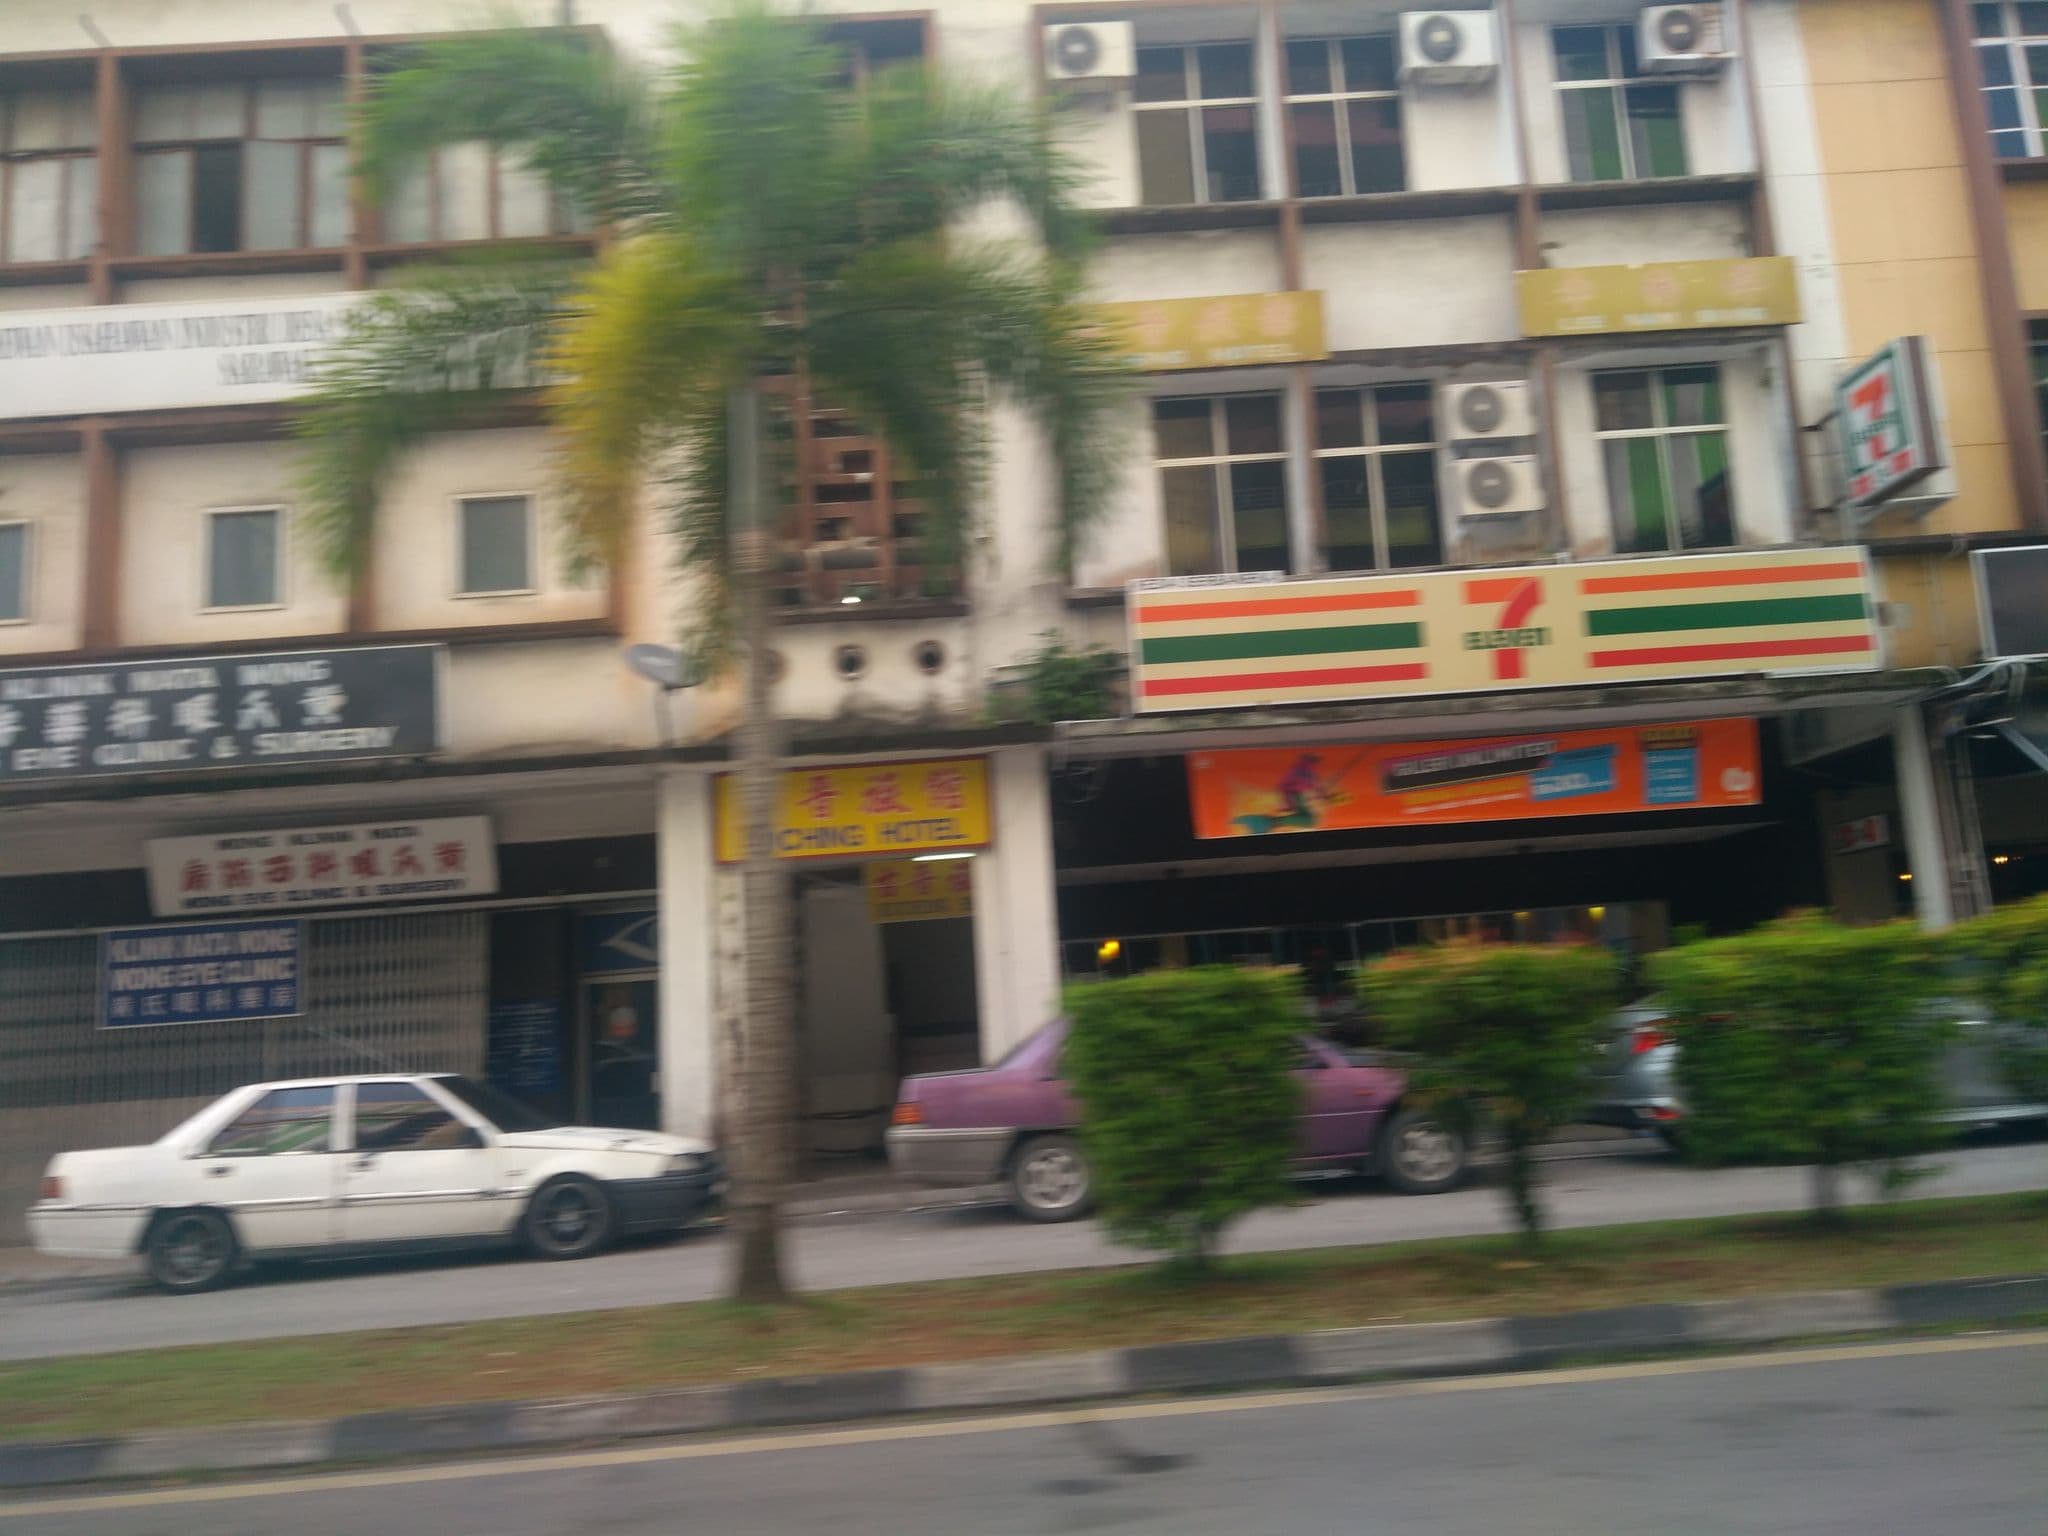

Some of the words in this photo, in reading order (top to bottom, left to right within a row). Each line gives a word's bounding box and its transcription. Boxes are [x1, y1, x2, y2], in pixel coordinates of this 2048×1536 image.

[1463, 576, 1545, 680] 7
[11, 746, 80, 771] EYE
[93, 738, 199, 765] CLINIC
[209, 735, 240, 759] &
[252, 726, 399, 755] SURGERY
[877, 817, 968, 844] HOTEL
[176, 962, 226, 987] EYE
[227, 957, 294, 984] CLINIC
